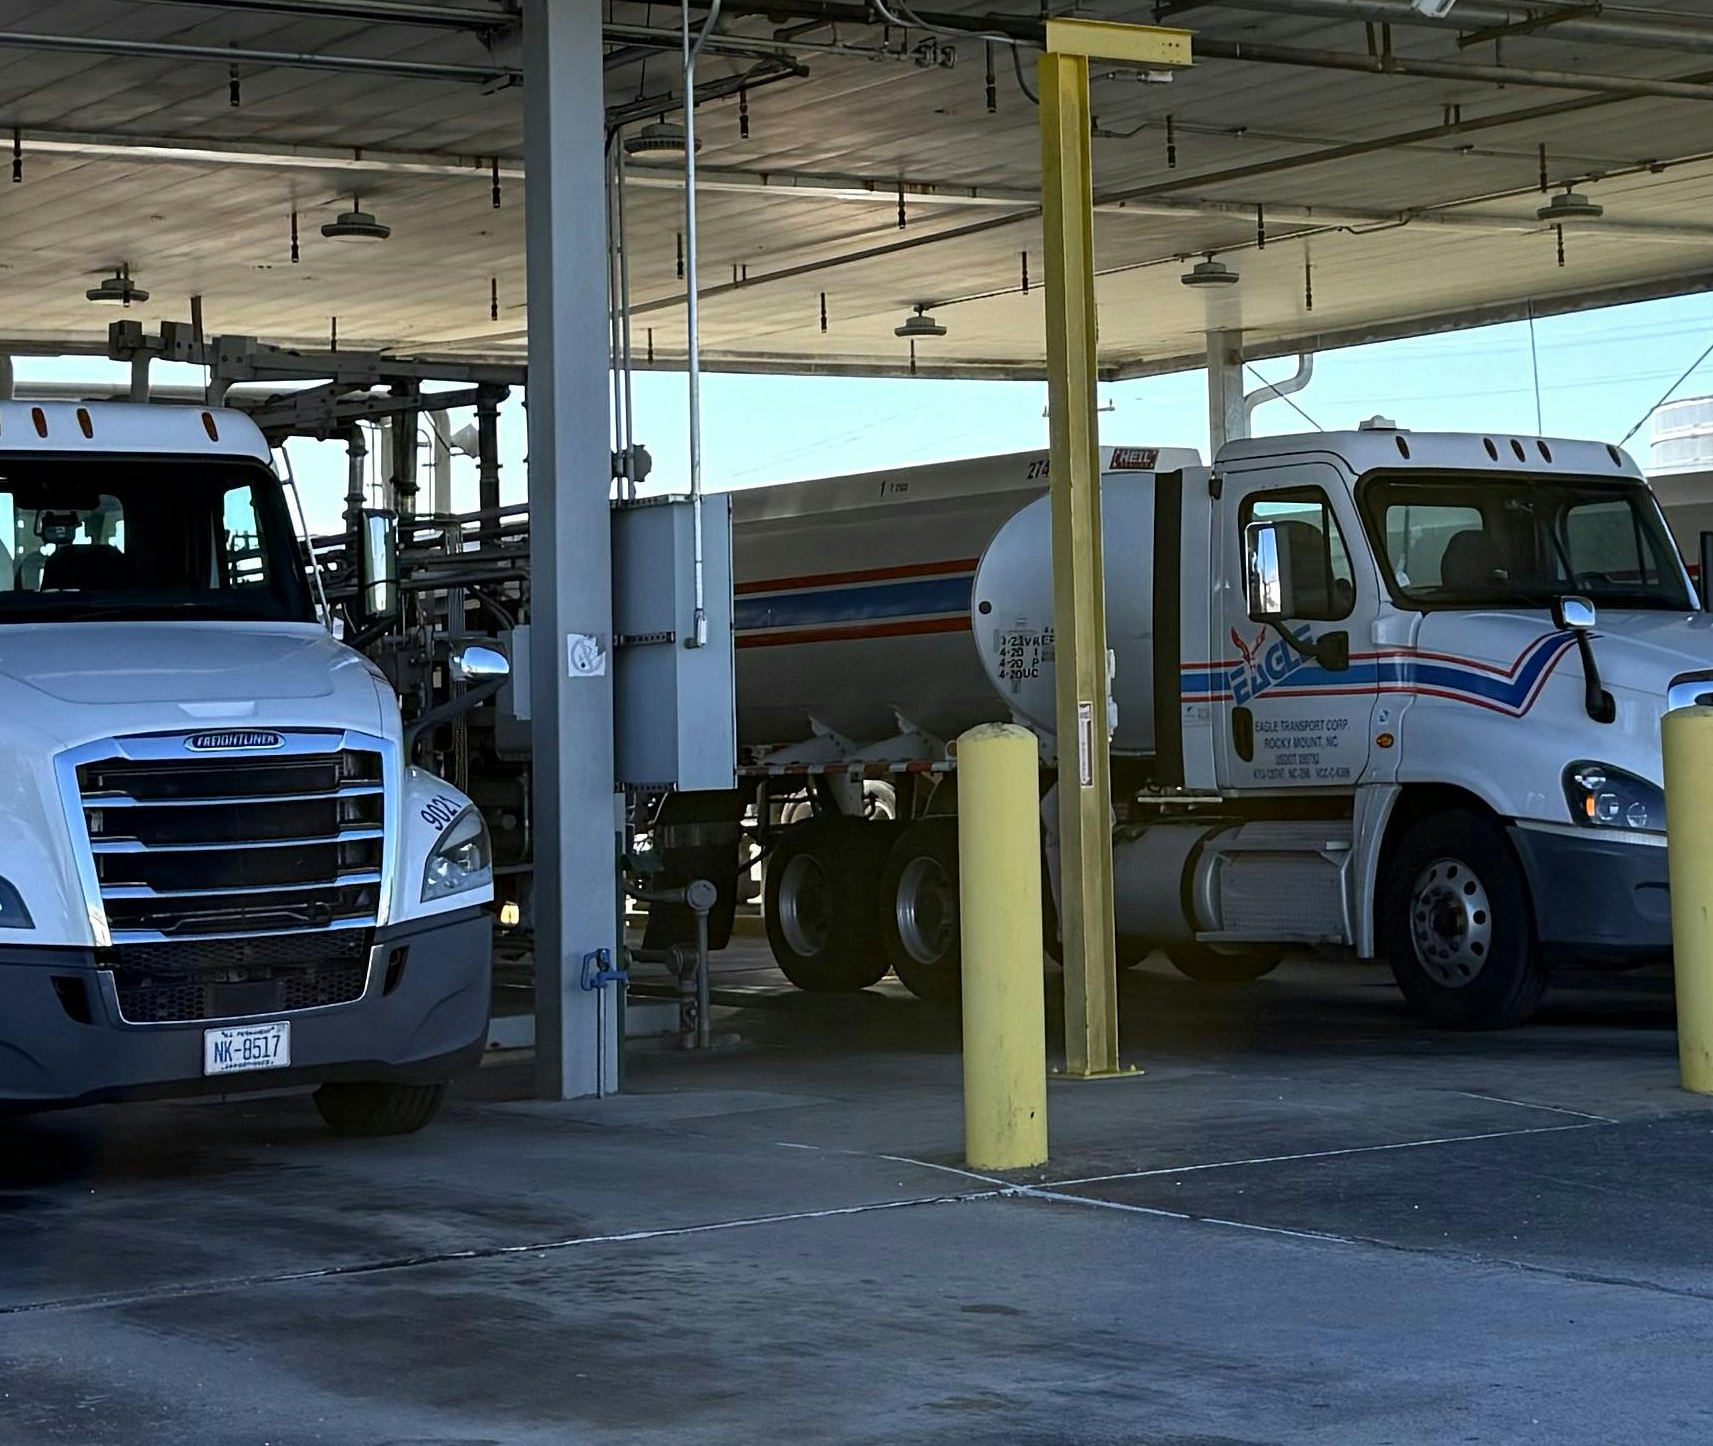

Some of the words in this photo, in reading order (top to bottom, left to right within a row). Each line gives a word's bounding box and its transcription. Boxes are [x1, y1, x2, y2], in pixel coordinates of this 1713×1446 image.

[1280, 719, 1325, 732] TRANSPORT
[197, 733, 275, 747] FREIGHTLINER
[1264, 737, 1291, 749] ROCKY
[1326, 735, 1338, 747] NC
[420, 794, 462, 832] 9021
[214, 1034, 281, 1064] NK-8517
